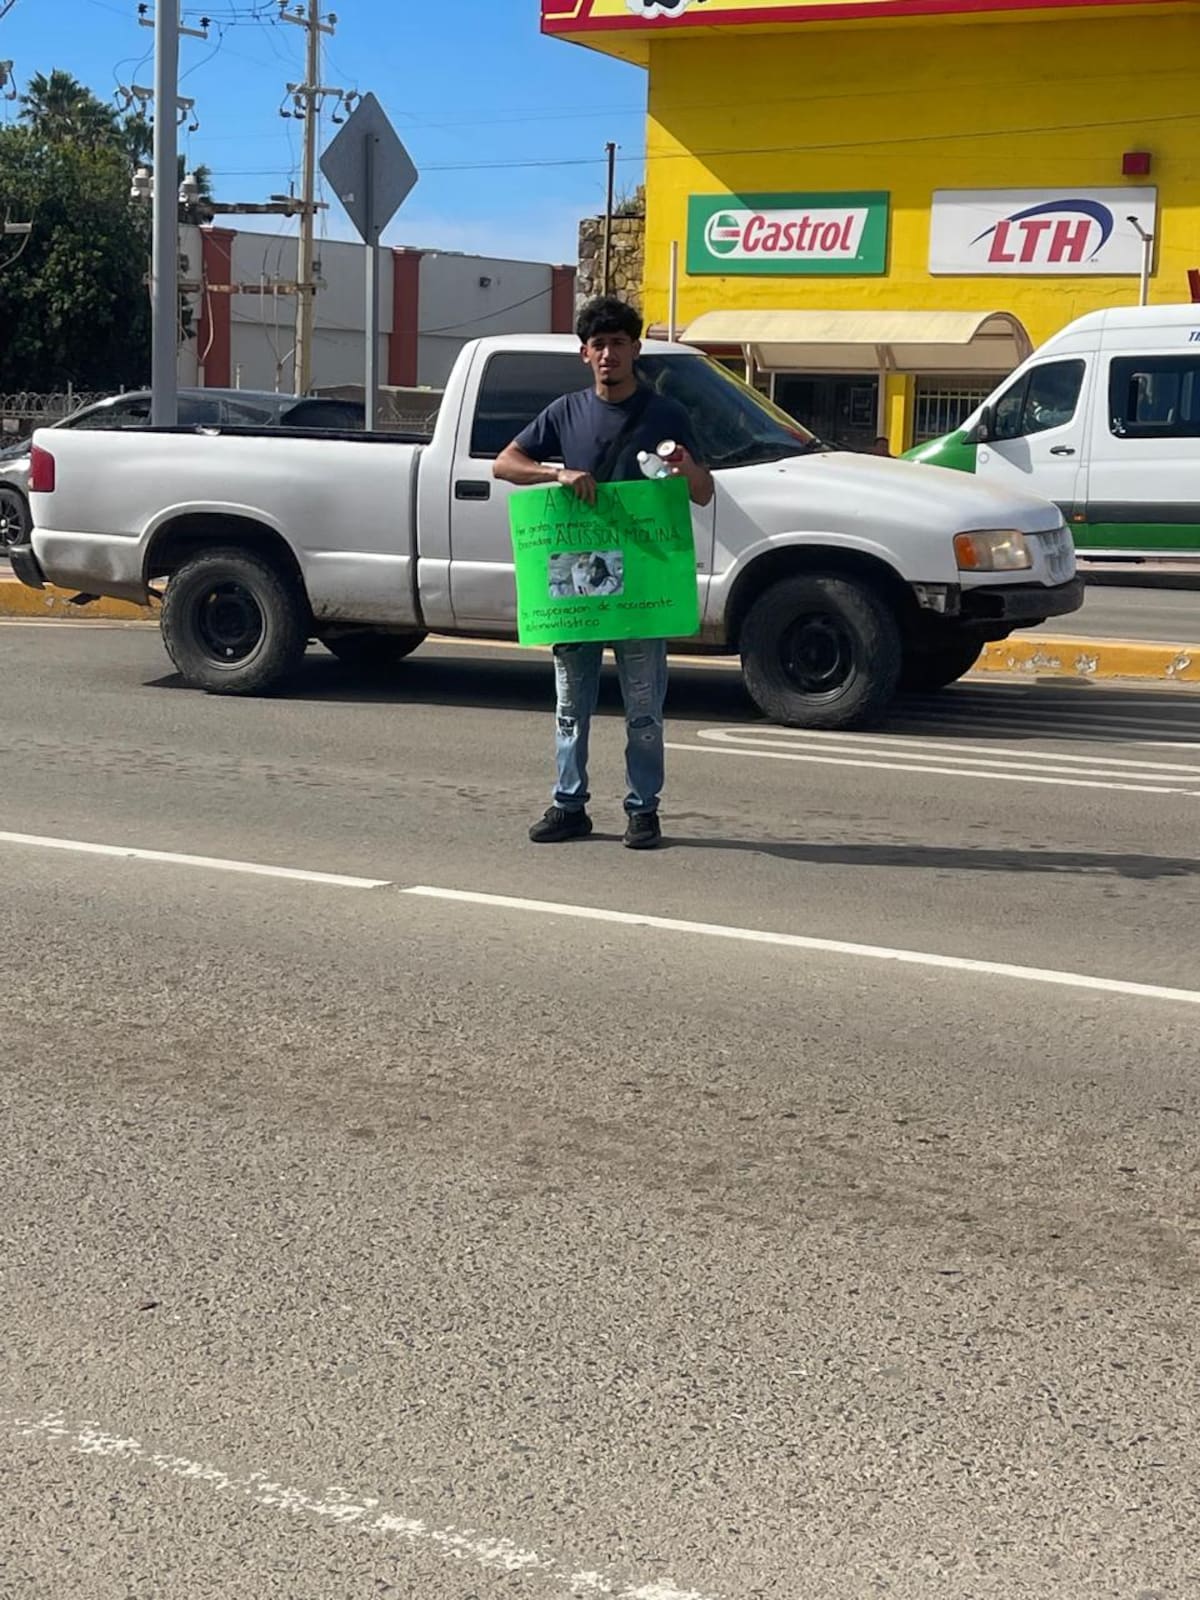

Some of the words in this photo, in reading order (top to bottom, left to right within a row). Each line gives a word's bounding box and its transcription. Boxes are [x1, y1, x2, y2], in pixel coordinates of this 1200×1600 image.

[742, 215, 854, 252] Castrol
[988, 220, 1092, 263] LTH
[555, 527, 619, 546] ALISSON
